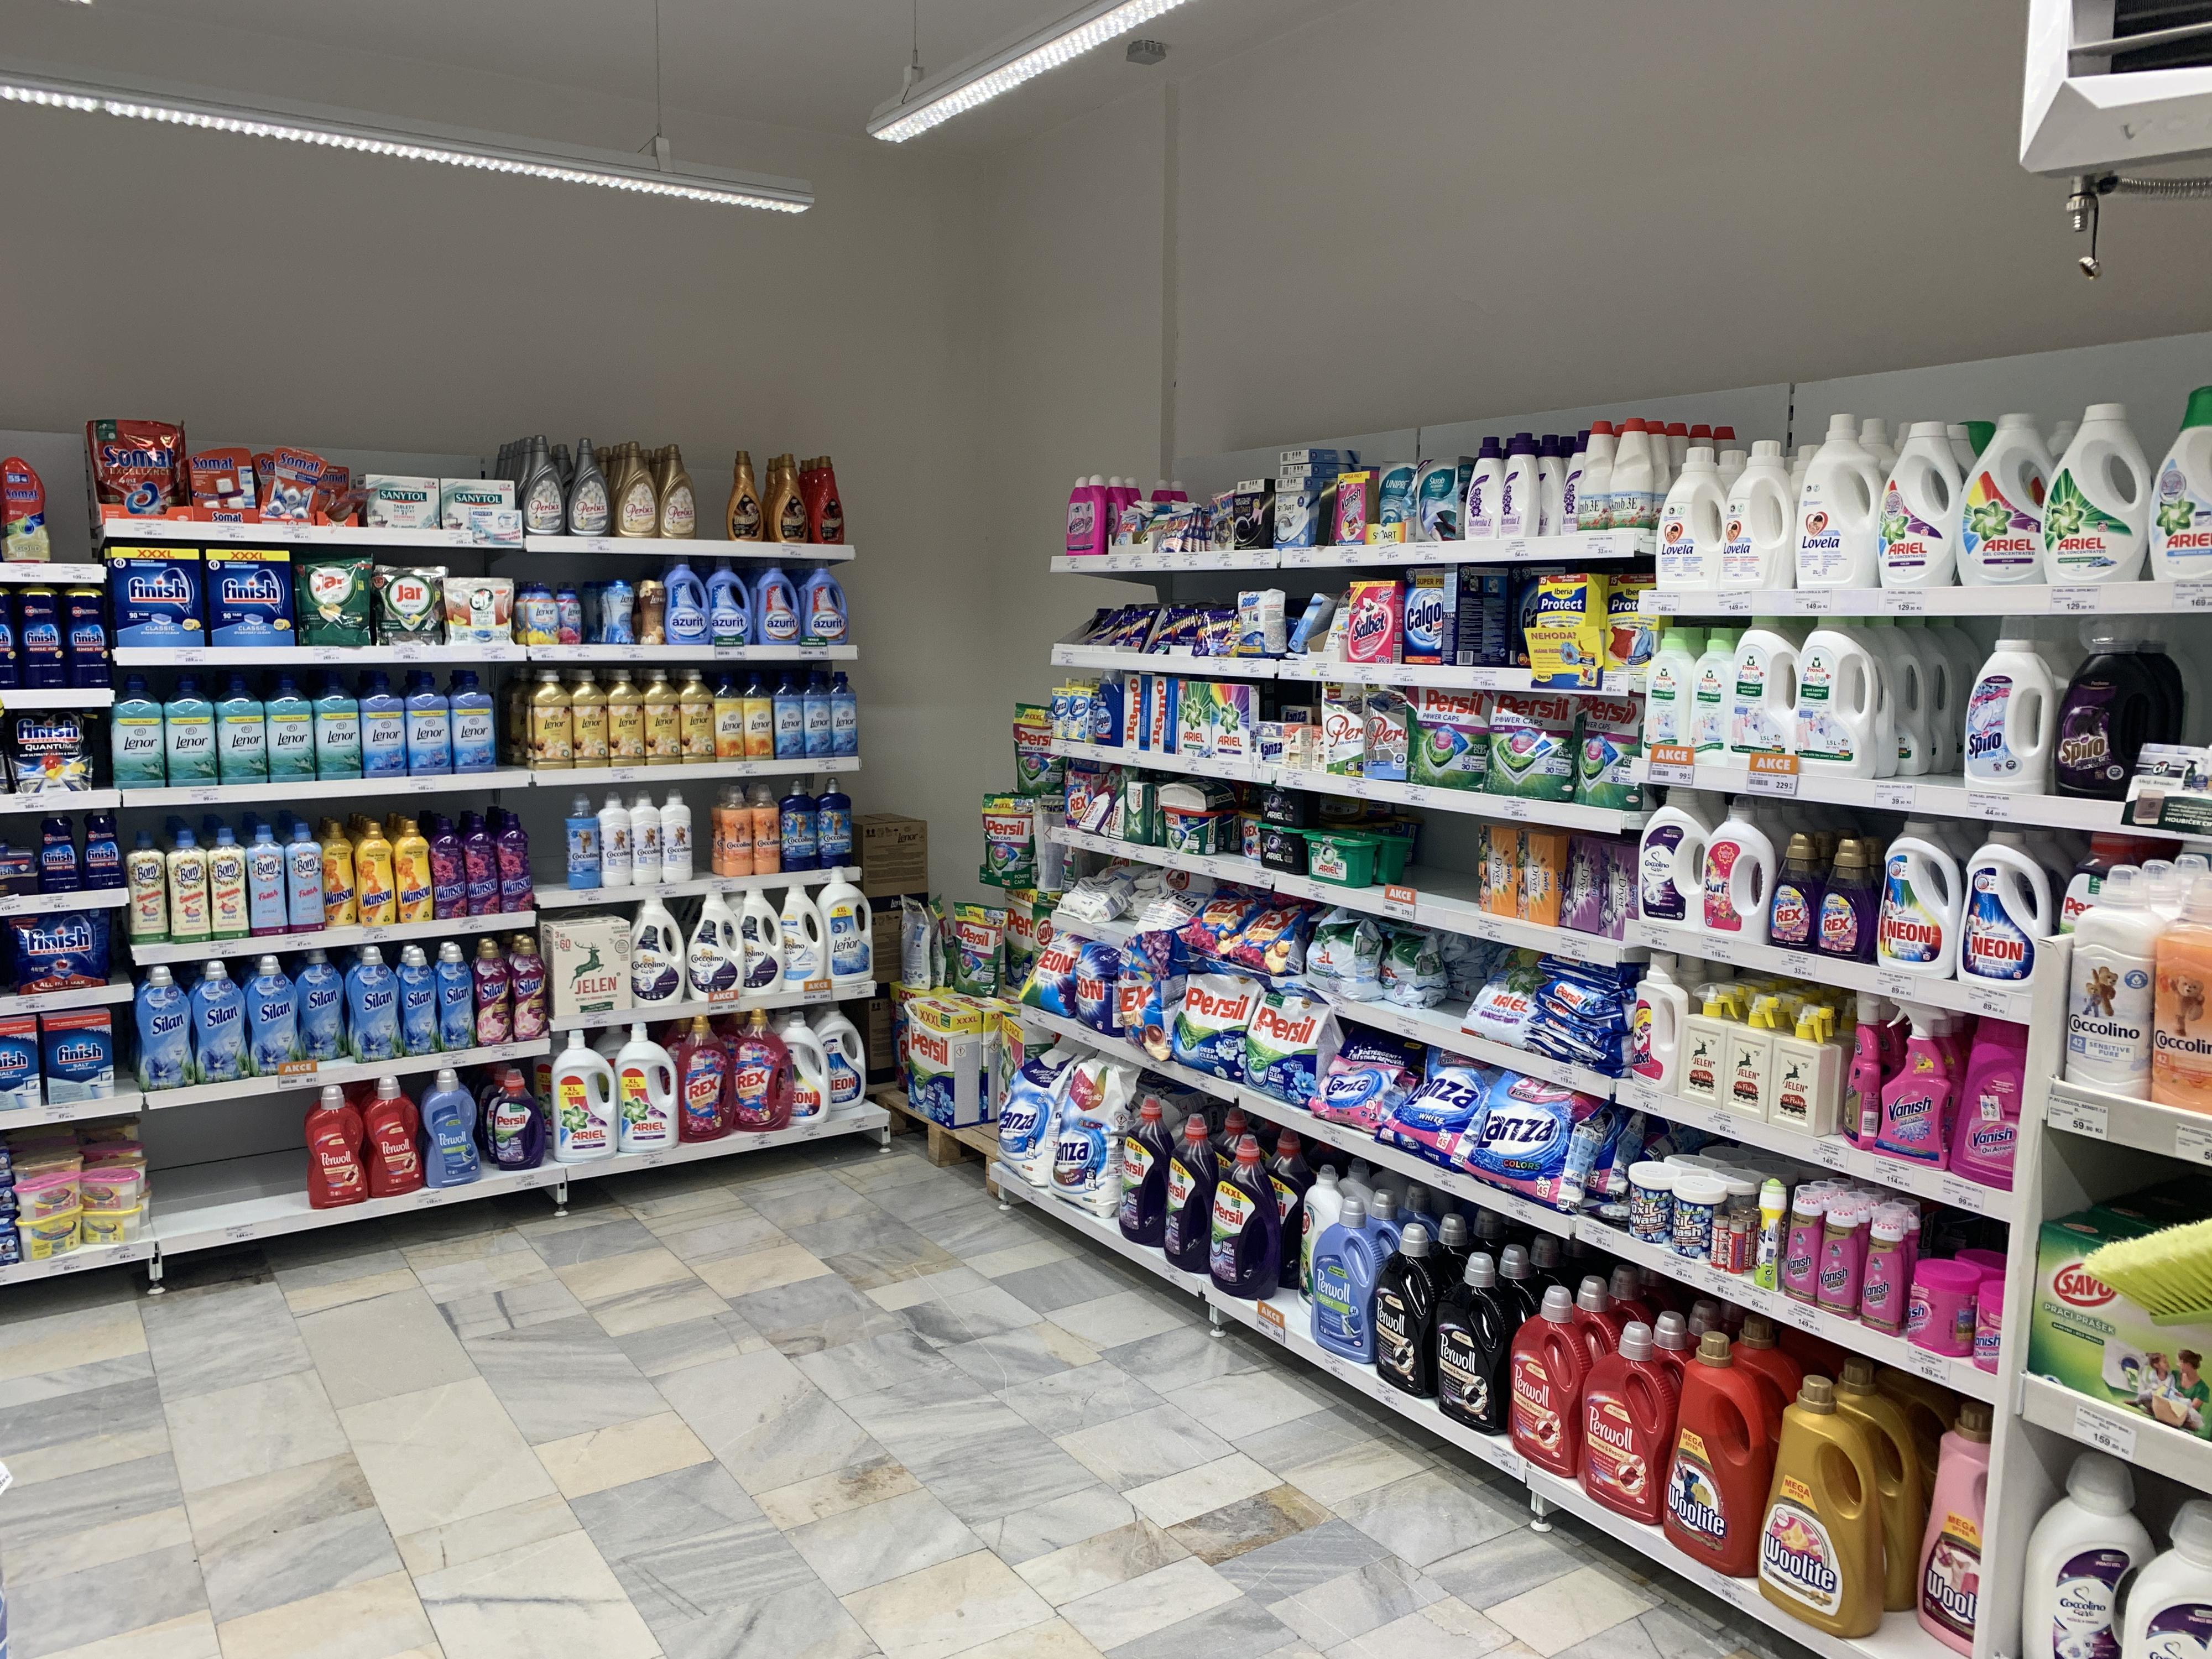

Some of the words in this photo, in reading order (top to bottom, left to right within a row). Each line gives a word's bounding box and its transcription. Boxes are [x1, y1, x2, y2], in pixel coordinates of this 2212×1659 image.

[192, 457, 234, 471] Somat
[280, 452, 320, 472] Somat
[1429, 475, 1446, 486] Škrob
[531, 502, 561, 517] Perlux
[576, 503, 607, 518] Perlux
[626, 504, 654, 517] Perlux
[1590, 499, 1600, 512] 3E
[1802, 538, 1840, 549] Lovela
[1983, 539, 2036, 552] ARIEL
[2167, 533, 2212, 548] ARIE
[138, 550, 174, 559] XXXL
[1662, 544, 1693, 555] Lovela
[1723, 543, 1751, 555] Lovela
[1888, 543, 1927, 555] ARIEL
[129, 577, 187, 597] finish
[397, 585, 422, 601] Jar
[1541, 598, 1583, 610] Protect
[672, 617, 703, 628] azurit
[712, 617, 743, 628] azurit
[767, 618, 795, 628] azurit
[1407, 601, 1443, 632] Calgo
[813, 619, 843, 629] azurit
[1354, 613, 1385, 640] Salbet
[1531, 632, 1577, 640] NEHODA?
[1375, 655, 1385, 664] 700
[1803, 673, 1826, 685] baby
[1425, 690, 1483, 716] Persil
[125, 737, 156, 750] Lenor
[176, 736, 208, 749] Lenor
[232, 735, 262, 748] Lenor
[278, 733, 307, 745] Lenor
[1656, 749, 1687, 761] AKCE
[2062, 737, 2106, 766] Spiro
[2165, 816, 2195, 827] HOUBIČEK
[297, 857, 316, 872] Bony
[138, 864, 158, 881] Bony
[181, 865, 200, 881] Bony
[1531, 864, 1540, 893] Dryer
[436, 883, 465, 900] Wansou
[1705, 878, 1726, 894] Surf
[259, 889, 278, 900] Fresh
[325, 887, 354, 906] Wansou
[362, 889, 392, 907] Wansou
[1389, 889, 1412, 902] AKCE
[1776, 908, 1802, 922] REX
[1887, 920, 1931, 942] NEON
[560, 939, 571, 948] 60
[1971, 937, 2023, 961] NEON
[691, 954, 724, 963] Coccolino
[575, 977, 617, 995] JELEN
[309, 990, 337, 1009] Silan
[364, 991, 393, 1010] Silan
[408, 991, 431, 1008] Silan
[1186, 987, 1250, 1021] Persil
[152, 1014, 184, 1035] Silan
[2069, 1014, 2140, 1040] Coccolino
[1010, 1025, 1020, 1039] PACK
[2073, 1038, 2083, 1047] 42
[2089, 1041, 2131, 1053] SENSITIVE
[58, 1044, 102, 1061] finish
[2099, 1050, 2119, 1058] PURE
[284, 1064, 312, 1073] AKCE
[1378, 1056, 1405, 1067] REMOVAL
[1269, 1071, 1284, 1080] CLEAN
[689, 1077, 718, 1098] REX
[1327, 1076, 1370, 1096] Lanza
[1783, 1095, 1790, 1104] Na
[1791, 1096, 1805, 1107] Fleky
[1888, 1095, 1933, 1122] Vanish
[497, 1115, 526, 1125] Persil
[1418, 1112, 1445, 1125] WHITE
[632, 1122, 666, 1131] ARIEL
[572, 1129, 607, 1140] ARIEL
[1973, 1129, 2013, 1146] Vanish
[1992, 1144, 2012, 1152] Action
[321, 1151, 351, 1167] Perwoll
[1503, 1159, 1542, 1171] COLORS
[1220, 1185, 1242, 1199] XXXL
[1537, 1186, 1548, 1197] 45
[1214, 1201, 1243, 1226] Persil
[1632, 1213, 1667, 1225] Wash
[1787, 1255, 1812, 1271] Vanish
[1820, 1266, 1848, 1283] Vanish
[1319, 1295, 1334, 1307] Sport
[2044, 1303, 2074, 1321] PRACÍ
[2076, 1313, 2116, 1335] PRÁŠEK
[1441, 1332, 1476, 1374] Perwoll
[1515, 1364, 1550, 1408] Perwoll
[1589, 1405, 1633, 1453] Perwoll
[1590, 1437, 1604, 1450] Renew
[1609, 1448, 1625, 1460] Repair
[1784, 1478, 1810, 1497] MEGA
[1788, 1488, 1805, 1500] OFFER
[1669, 1482, 1726, 1540] Woolite
[1948, 1515, 1976, 1535] MEGA
[1764, 1531, 1837, 1593] Woolite
[2060, 1598, 2106, 1612] Coccolino
